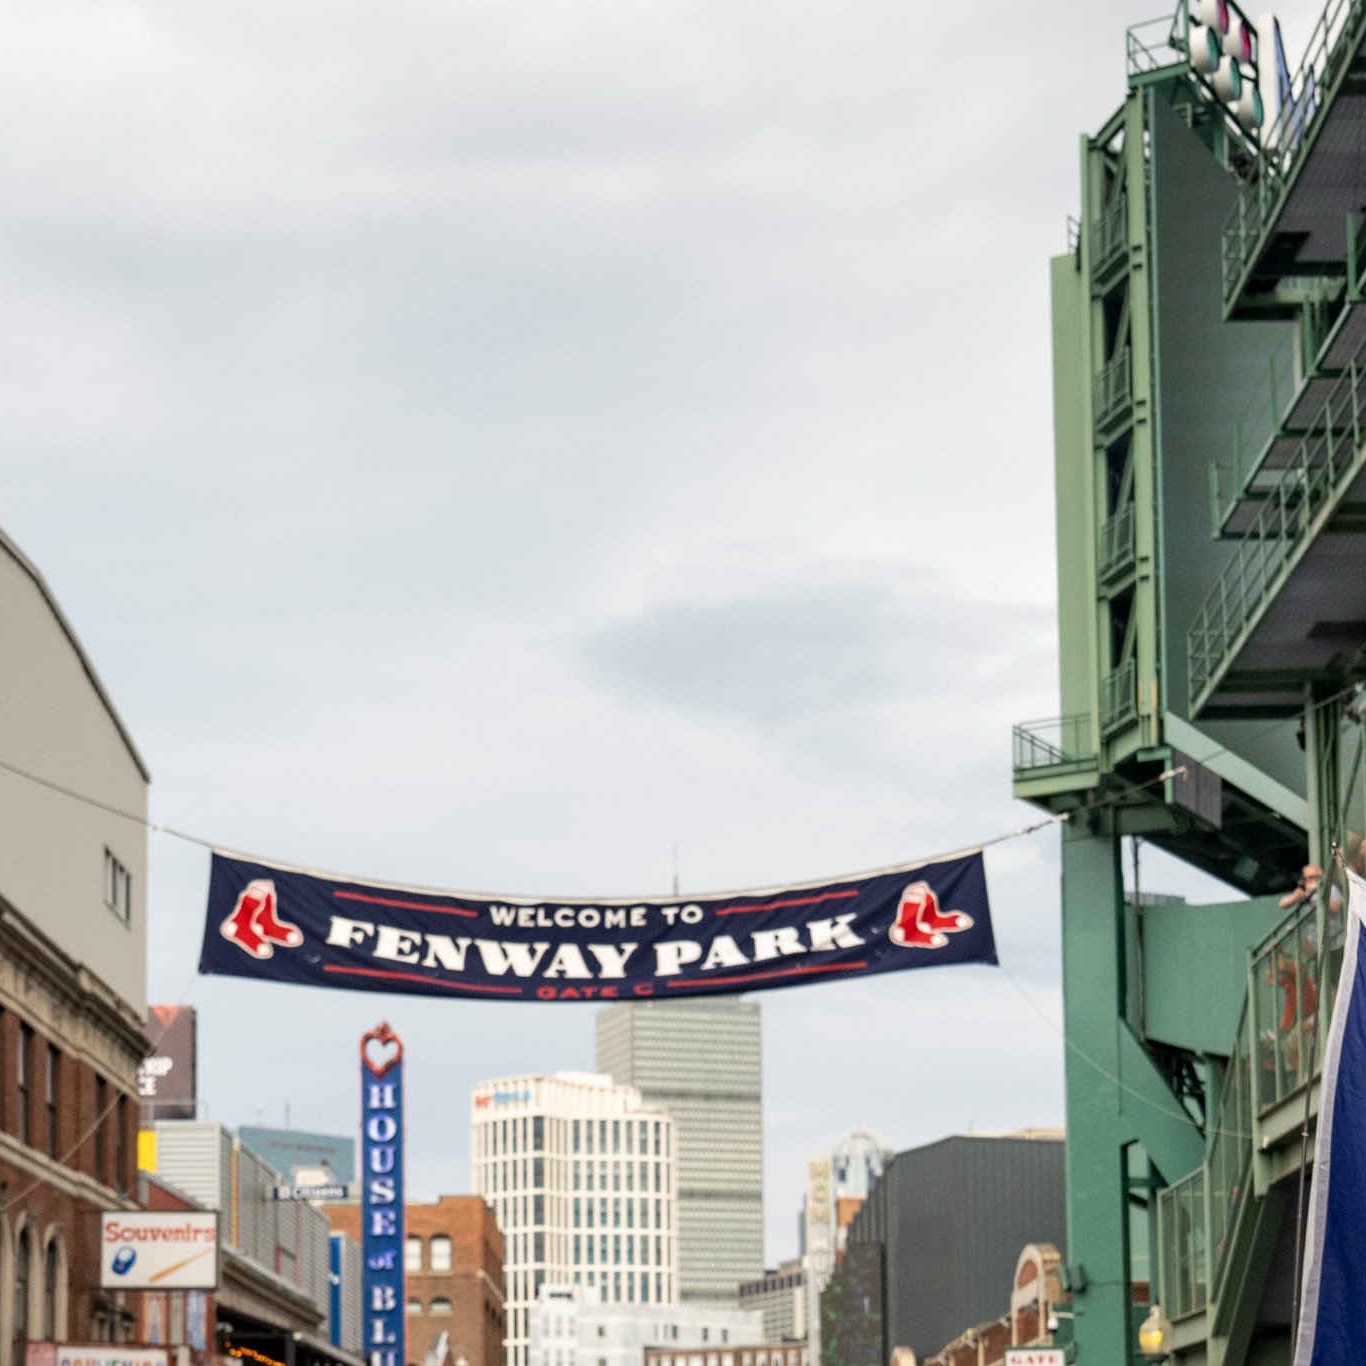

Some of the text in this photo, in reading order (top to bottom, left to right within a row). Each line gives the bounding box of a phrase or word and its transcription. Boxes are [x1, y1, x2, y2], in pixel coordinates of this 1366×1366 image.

[490, 904, 704, 929] WELCOME TO
[325, 912, 866, 979] FENWAY PARK
[537, 982, 654, 1000] GATE C
[367, 1084, 398, 1236] HOUSE
[104, 1221, 216, 1243] Souvenirs
[1011, 1354, 1061, 1365] GATE
